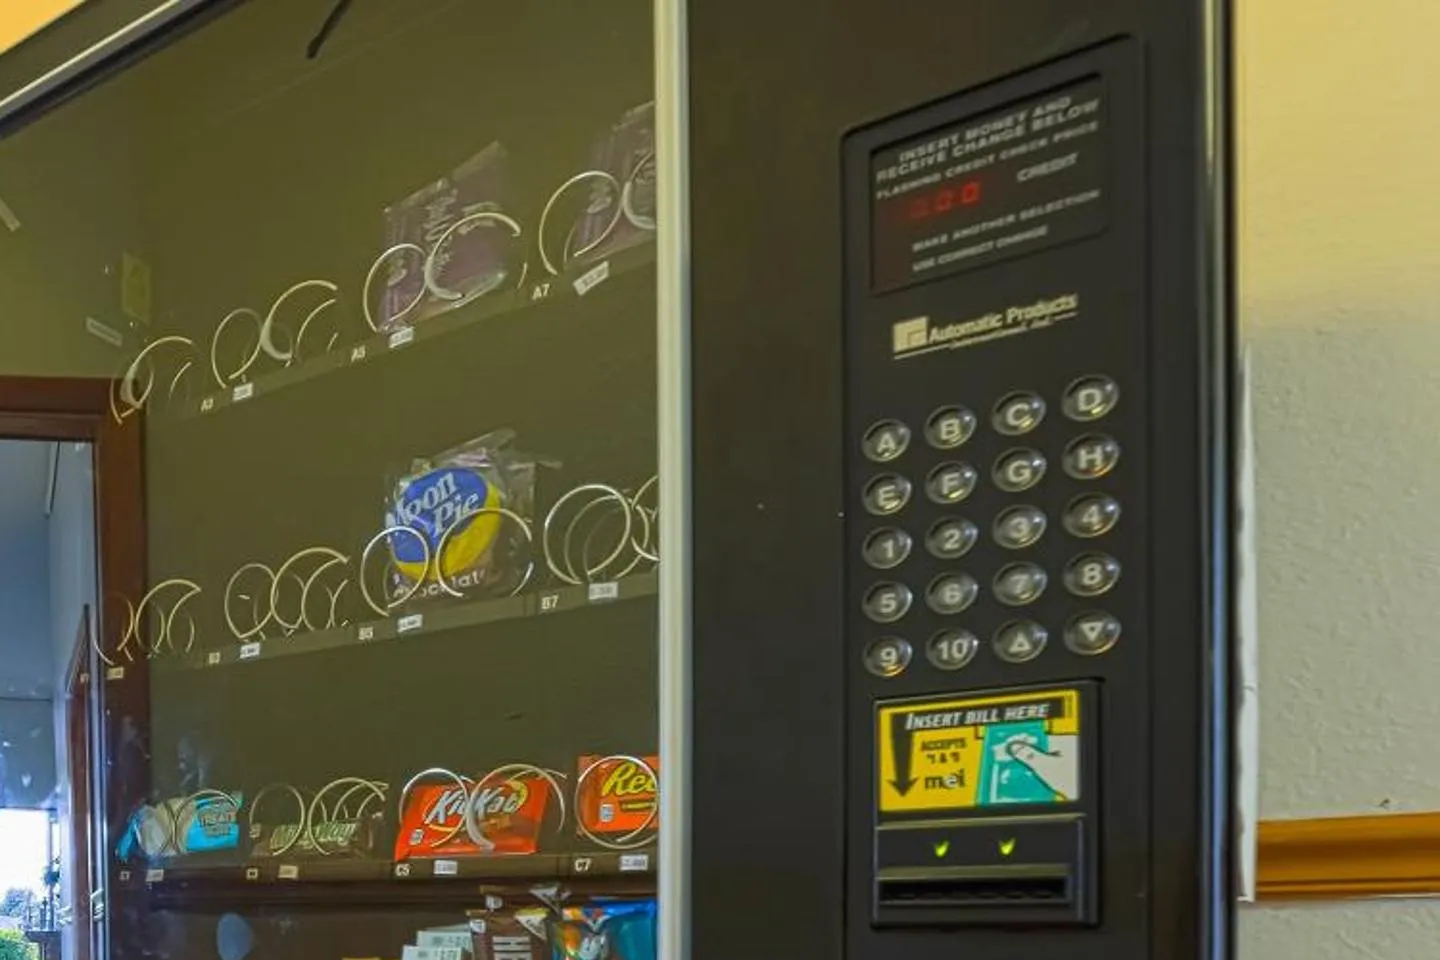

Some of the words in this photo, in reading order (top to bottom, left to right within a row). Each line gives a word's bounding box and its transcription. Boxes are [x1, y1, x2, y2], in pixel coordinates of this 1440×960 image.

[876, 151, 947, 182] RECEIVE
[952, 125, 1025, 157] CHANGE
[1031, 99, 1100, 132] BELOW
[899, 136, 959, 162] INSERT
[965, 111, 1027, 141] MONEY
[1032, 96, 1071, 119] AND
[1016, 153, 1078, 182] CREDIT
[532, 284, 550, 300] A7
[928, 312, 1003, 344] Automatic
[1006, 294, 1079, 323] Products
[1006, 403, 1030, 426] C
[1077, 388, 1103, 411] D
[1007, 460, 1032, 483] G
[1077, 446, 1104, 470] H
[434, 492, 480, 534] Pie
[944, 528, 961, 550] 2
[880, 592, 897, 613] 5
[944, 583, 961, 604] 6
[1082, 562, 1103, 586] 8
[938, 638, 969, 661] 10
[905, 711, 962, 731] INSERT
[1004, 702, 1051, 719] HERE
[924, 768, 967, 790] mei
